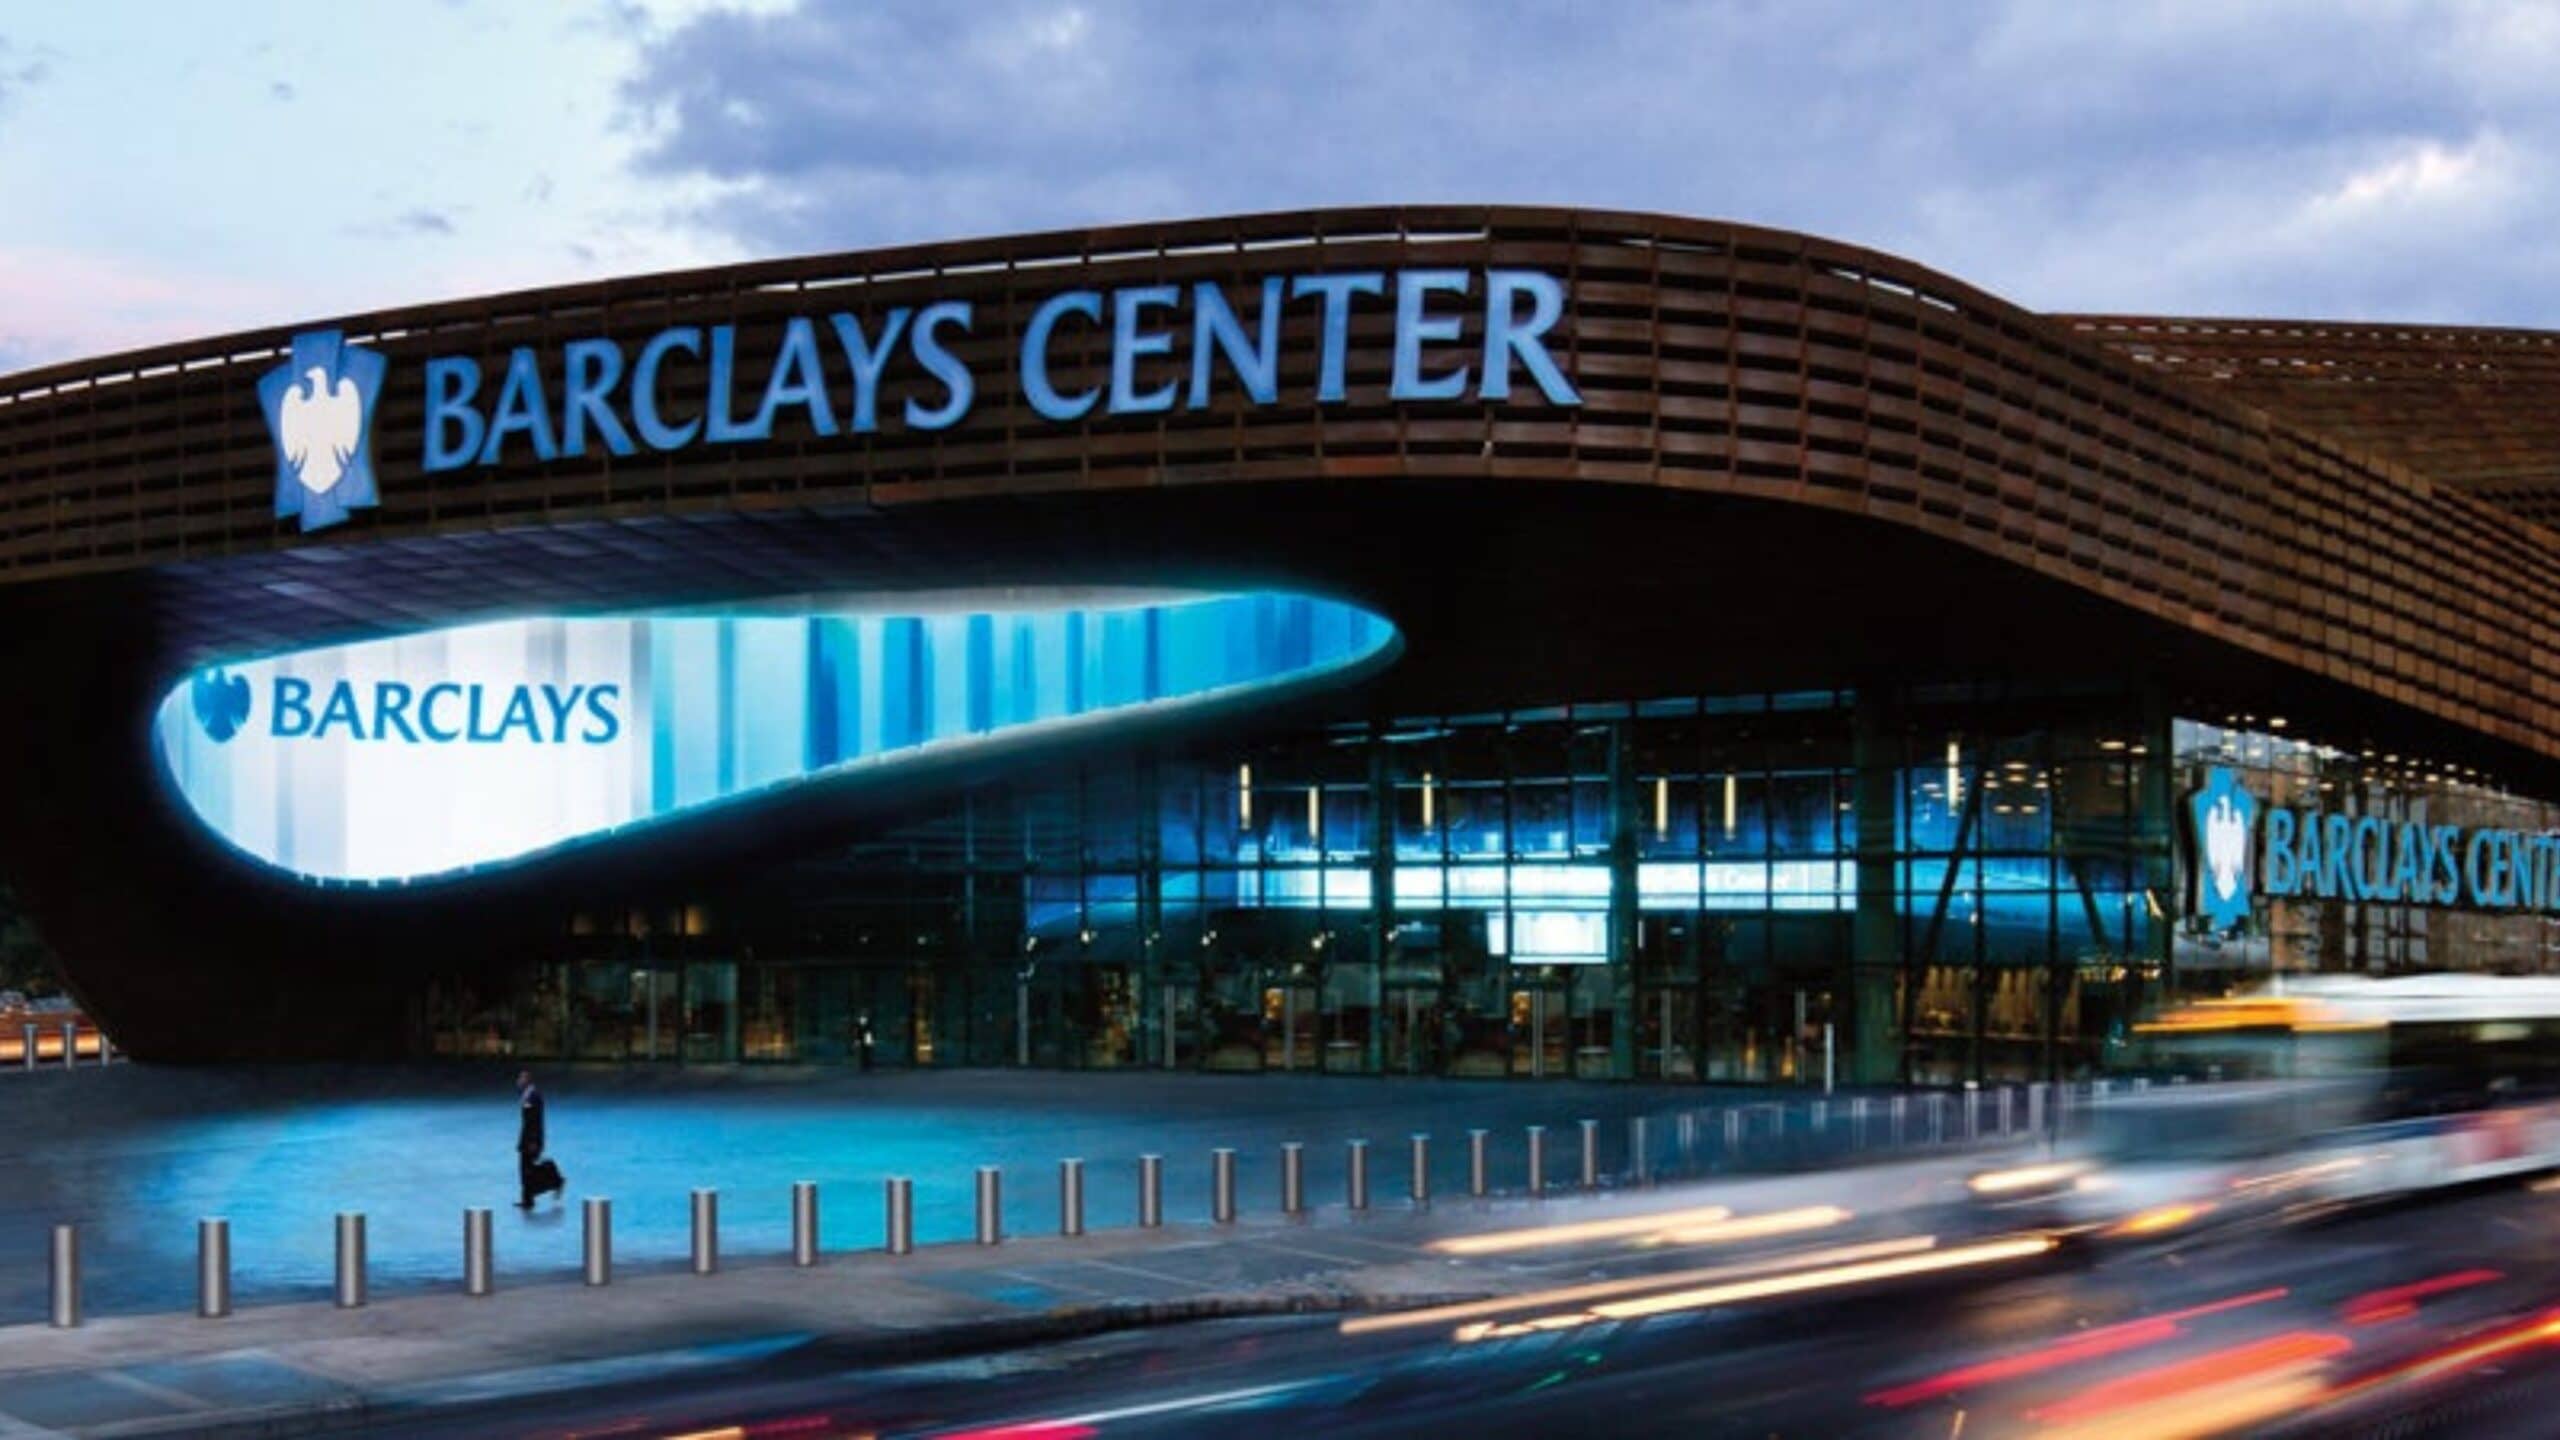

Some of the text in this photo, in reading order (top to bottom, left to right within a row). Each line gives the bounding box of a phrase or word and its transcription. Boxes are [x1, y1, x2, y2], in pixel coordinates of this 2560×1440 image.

[423, 269, 1584, 473] BARCLAYS CENTER
[270, 677, 619, 744] BARCLAYS
[2264, 808, 2459, 903] BARCLAYS
